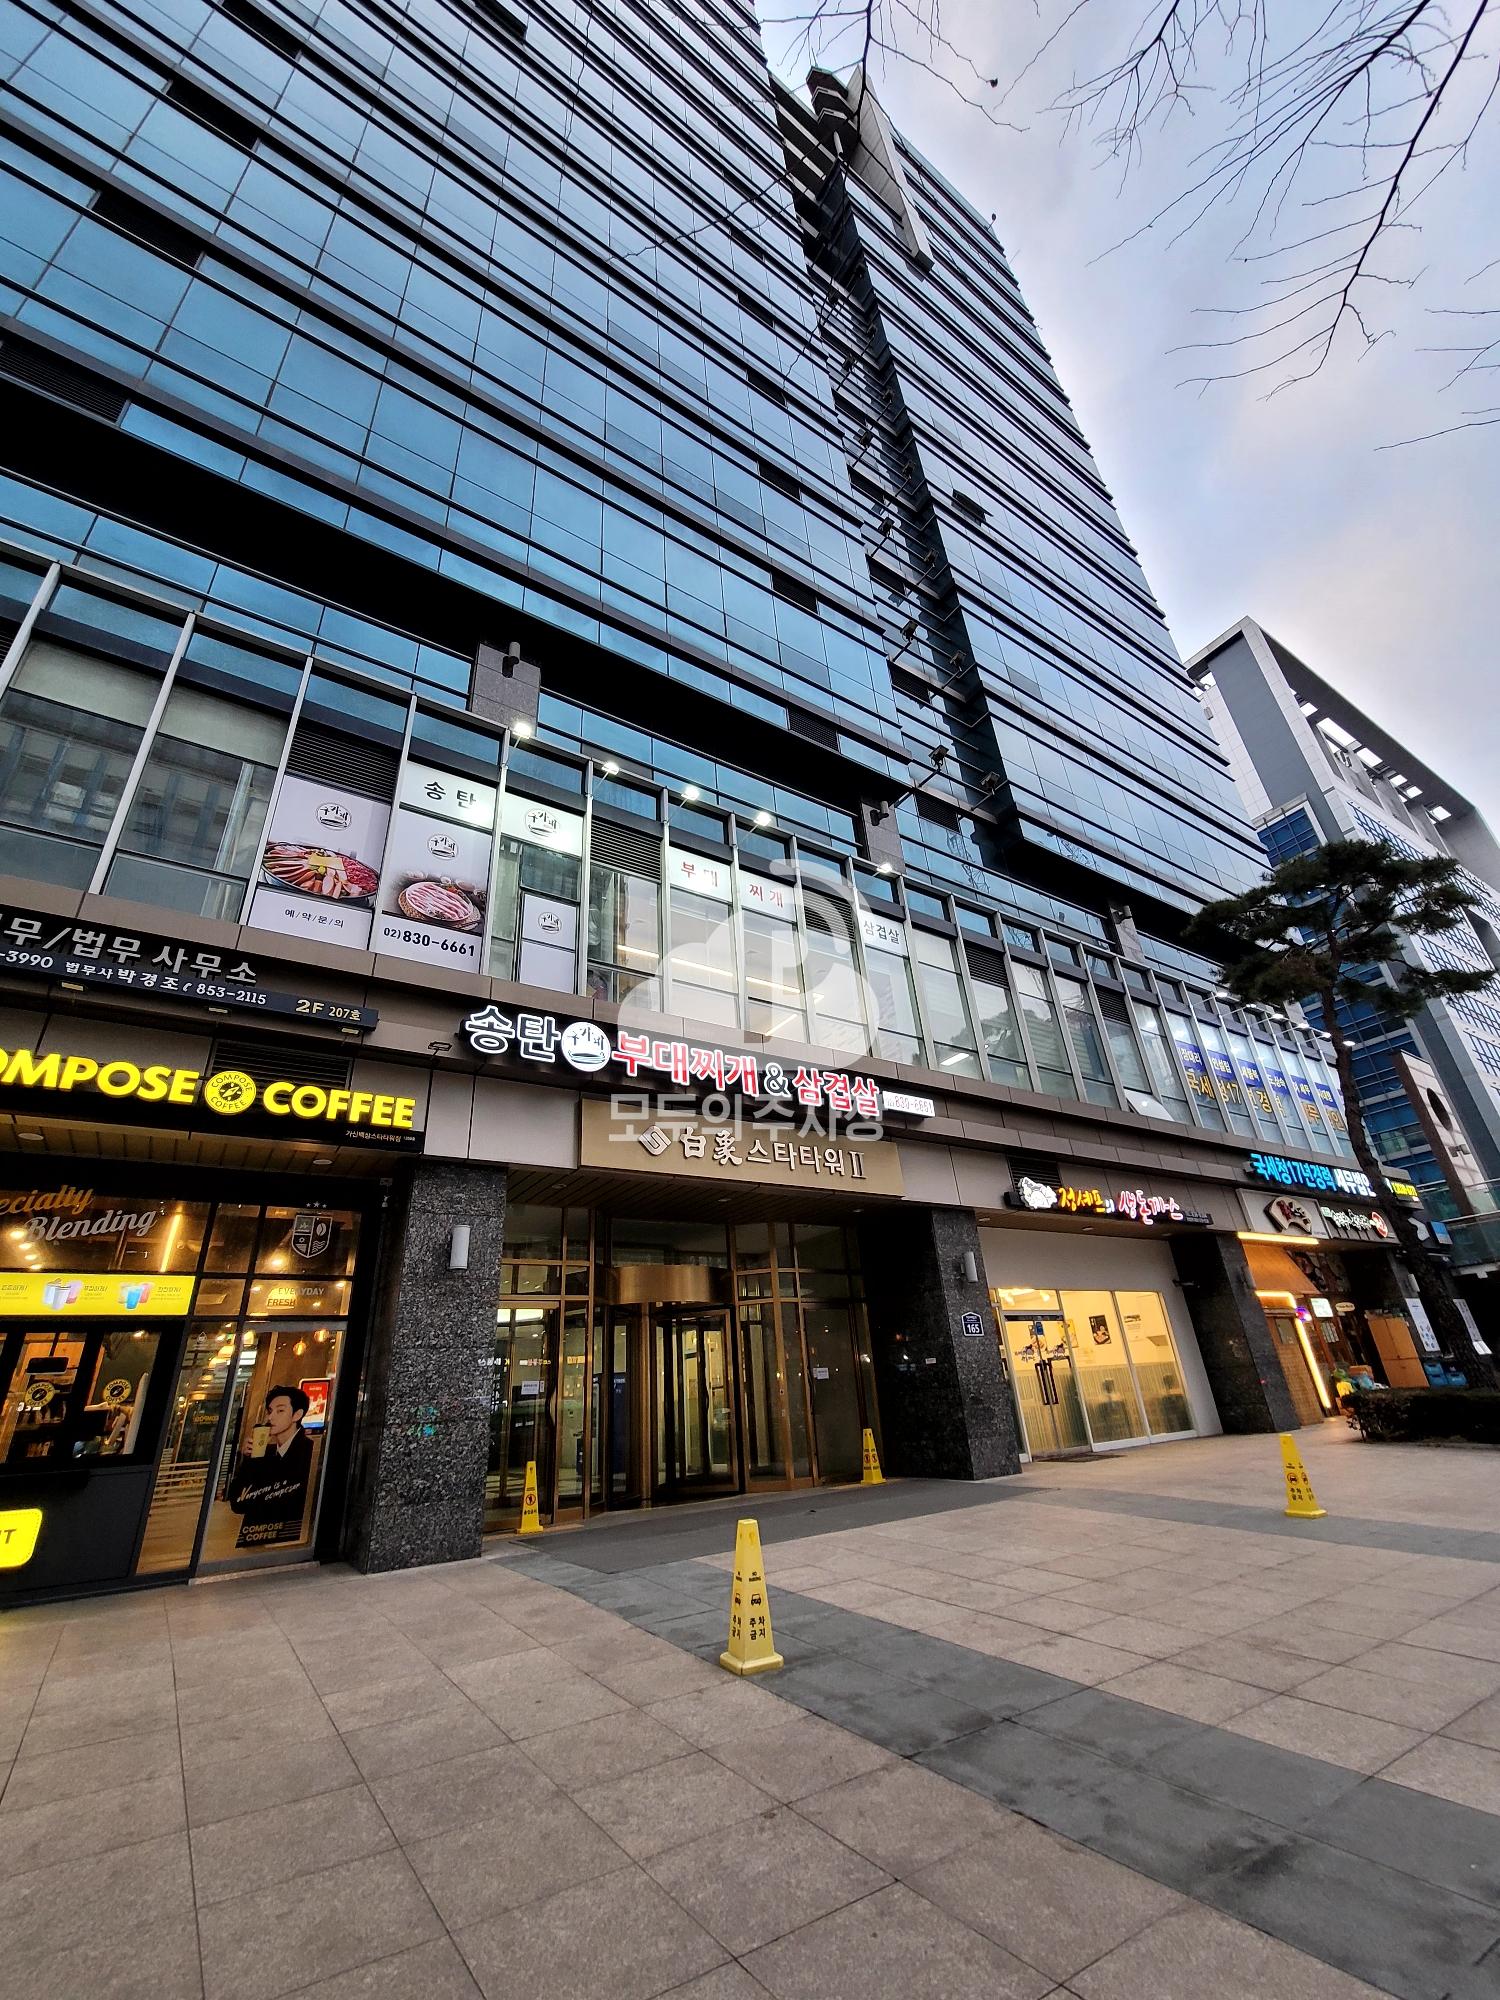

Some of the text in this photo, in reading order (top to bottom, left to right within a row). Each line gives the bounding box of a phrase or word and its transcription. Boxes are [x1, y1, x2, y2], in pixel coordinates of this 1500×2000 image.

[424, 780, 476, 807] 송탄
[681, 861, 718, 887] 부대
[749, 883, 784, 908] 찌개
[863, 920, 900, 945] 삼겹살
[284, 909, 342, 927] 예/약/문/의
[0, 913, 257, 984] 무/법무 사무소
[383, 927, 476, 957] 02)830-6661
[65, 961, 114, 980] 법무사
[117, 968, 179, 991] 박경조
[196, 983, 267, 1005] 853-2115
[295, 999, 325, 1014] 2F
[328, 1006, 361, 1021] 207호
[465, 1005, 562, 1063] 송탄
[612, 1031, 757, 1097] 부대찌개
[764, 1062, 791, 1097] &
[792, 1066, 880, 1117] 삼겹살
[0, 1047, 416, 1128] MPOSE COFFEE
[211, 1074, 252, 1091] COMPOSE
[210, 1096, 247, 1110] COFFEE
[747, 1139, 845, 1176] 스타타워
[24, 1209, 158, 1241] Blending
[267, 1299, 297, 1307] FRESH
[967, 1323, 980, 1333] 165
[242, 1522, 284, 1534] COMPOSE
[246, 1531, 278, 1542] COFFEE
[750, 1616, 765, 1627] 주차
[750, 1628, 766, 1640] 금지
